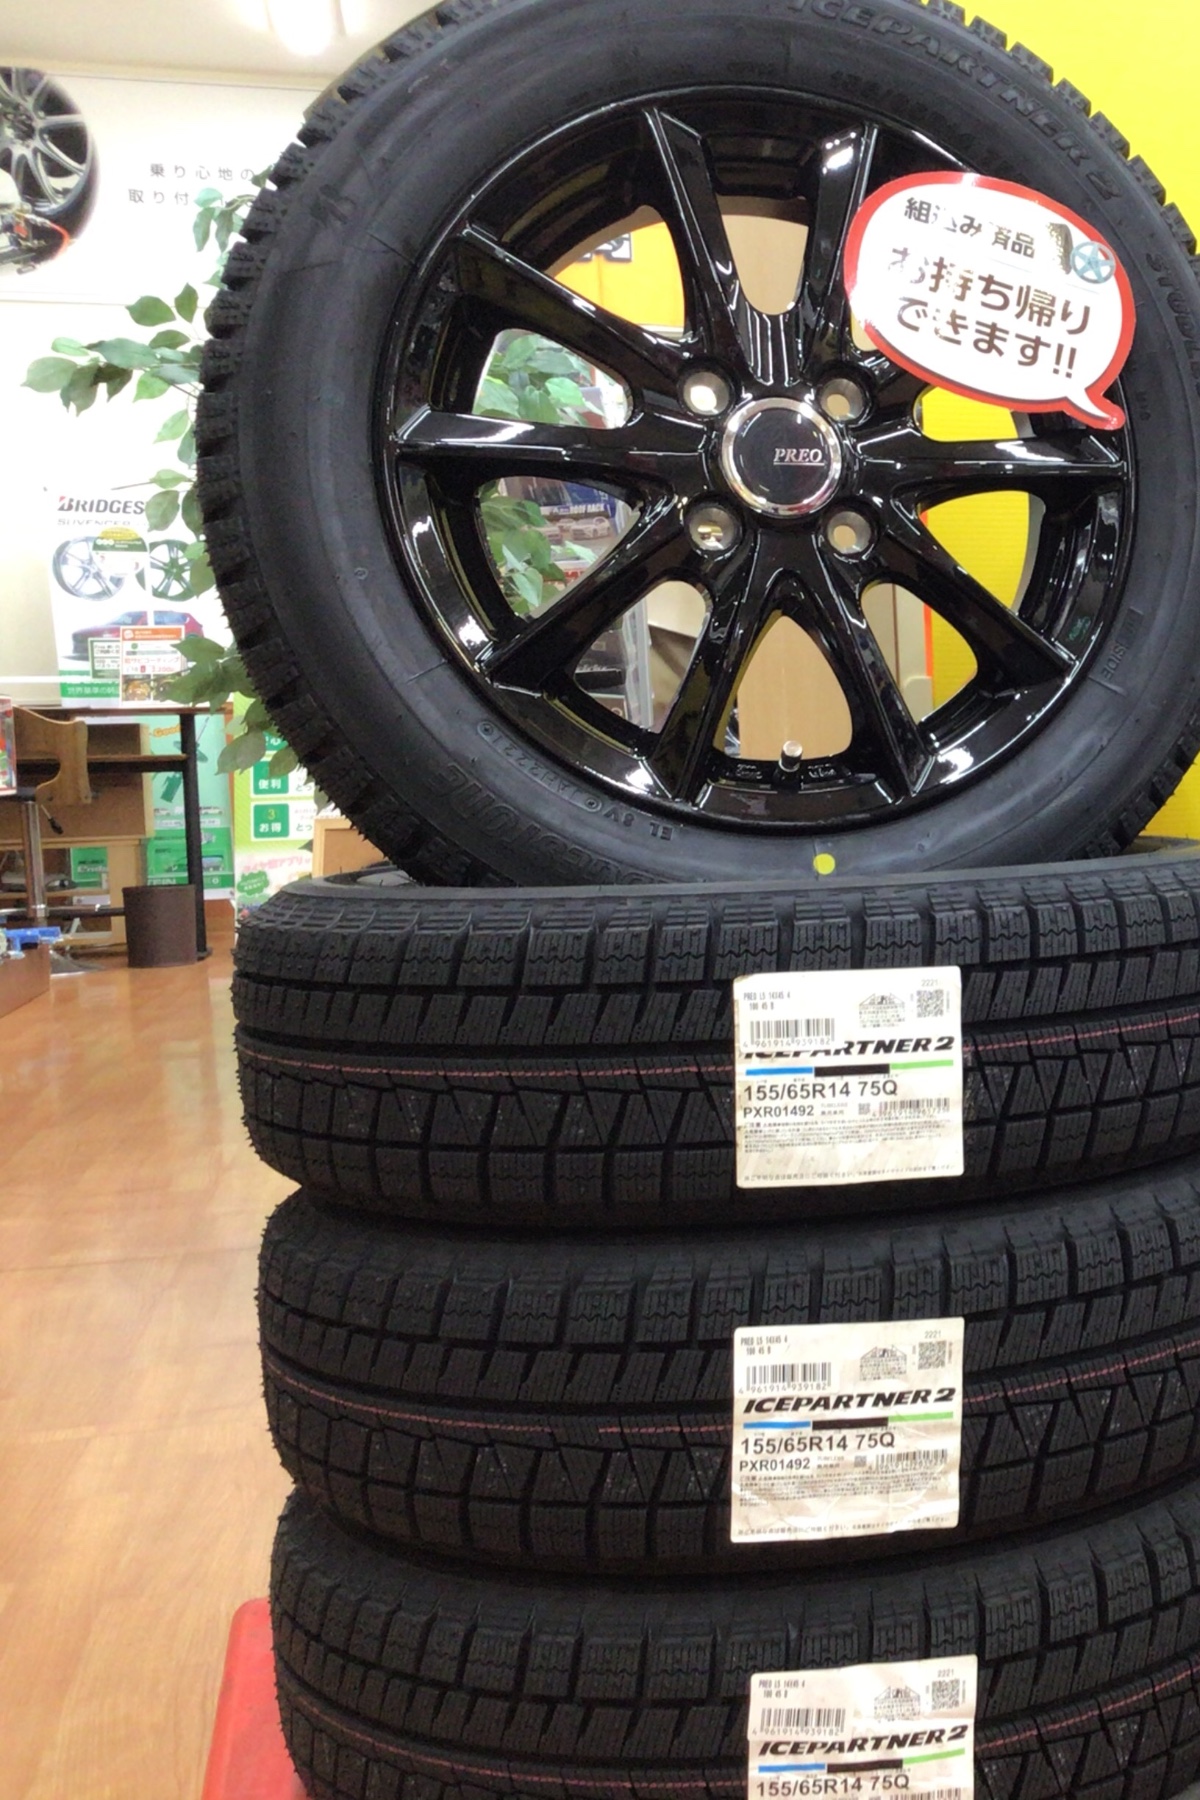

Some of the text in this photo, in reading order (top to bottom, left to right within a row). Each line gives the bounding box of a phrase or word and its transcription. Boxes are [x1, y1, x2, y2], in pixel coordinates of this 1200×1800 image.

[788, 0, 1090, 166] CEPARTNER
[773, 447, 823, 463] PREO
[57, 496, 145, 515] BRIDGES
[258, 778, 282, 790] 便利
[267, 809, 275, 820] 3
[258, 822, 282, 834] お得
[933, 1036, 955, 1052] 2
[743, 1079, 899, 1102] 155/65R14 75Q
[743, 1105, 815, 1119] PXR01492
[743, 1387, 957, 1414] ICEPARTNER 2
[740, 1431, 896, 1455] 155/65R14 75Q
[739, 1457, 811, 1472] PXR01492
[758, 1724, 969, 1757] ICEPARTNER 2
[756, 1773, 910, 1797] 155/65R14 75Q
